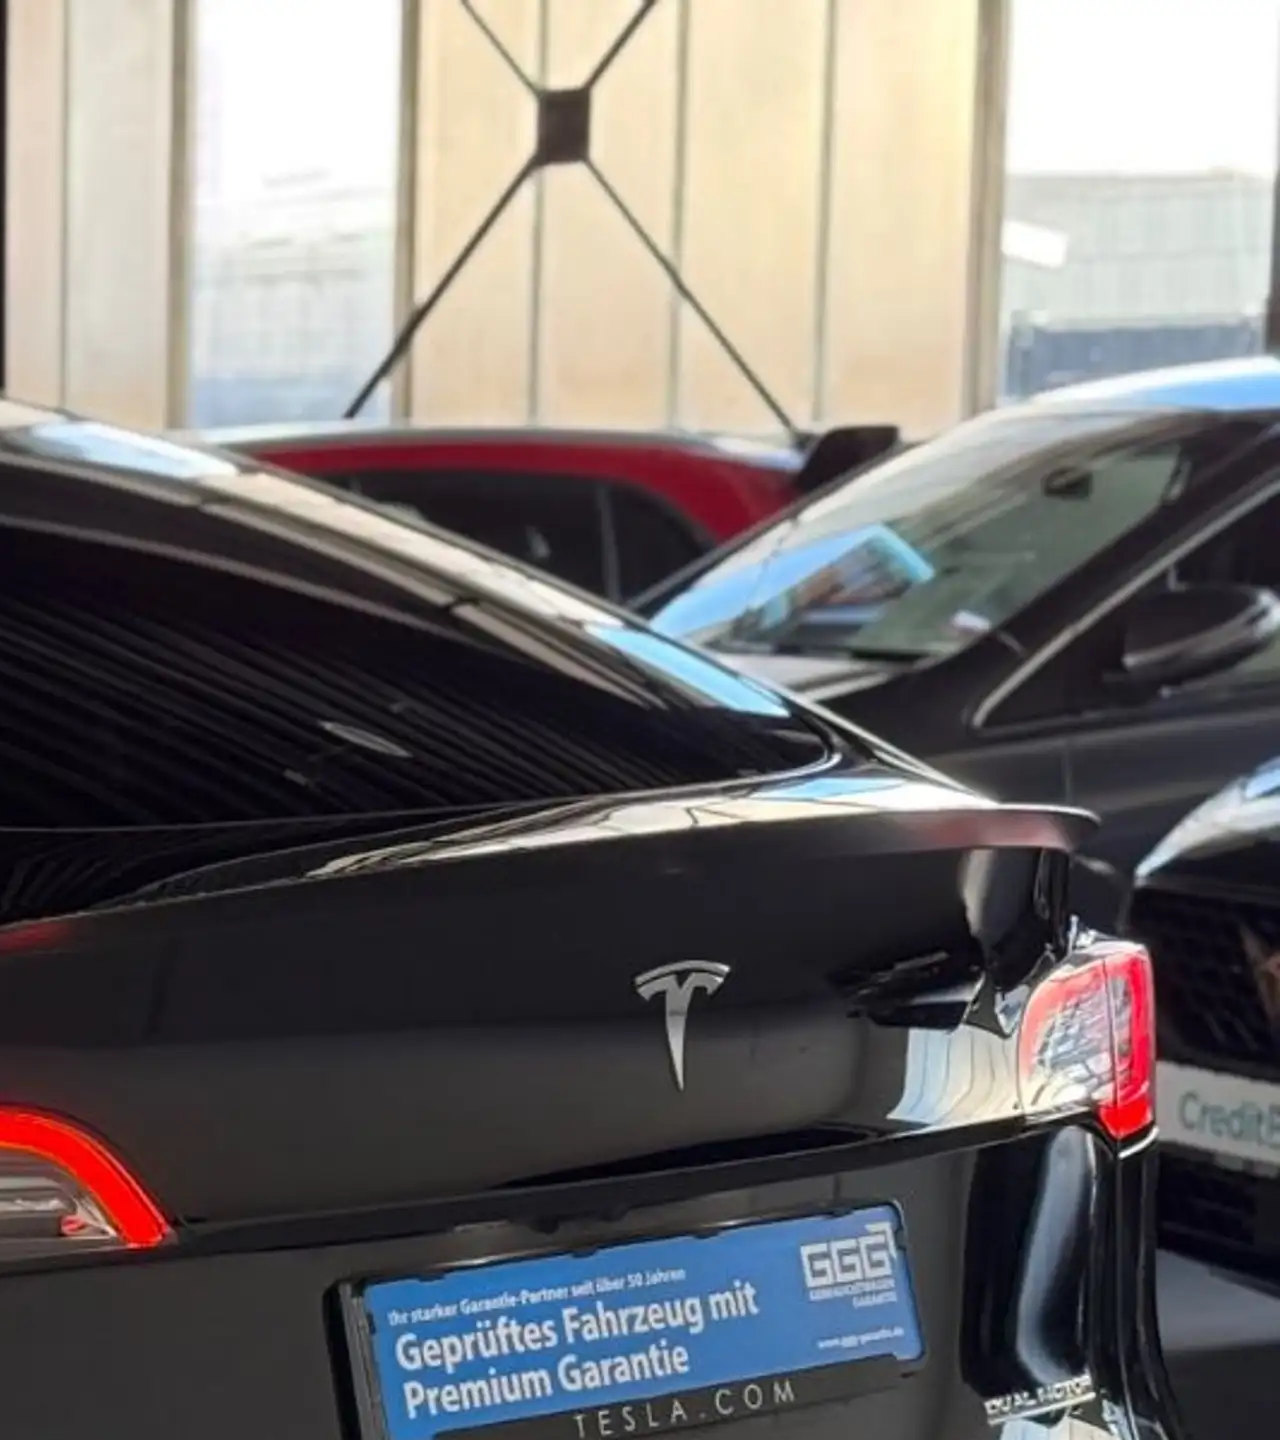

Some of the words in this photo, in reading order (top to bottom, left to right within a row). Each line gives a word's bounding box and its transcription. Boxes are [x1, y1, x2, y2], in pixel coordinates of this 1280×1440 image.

[800, 1234, 893, 1288] GGG
[395, 1315, 559, 1374] Geprüftes
[561, 1295, 705, 1344] Fahrzeug
[709, 1279, 760, 1321] mit
[403, 1366, 554, 1420] Premium
[557, 1338, 690, 1392] Garantie
[573, 1379, 795, 1439] TESLA.COM
